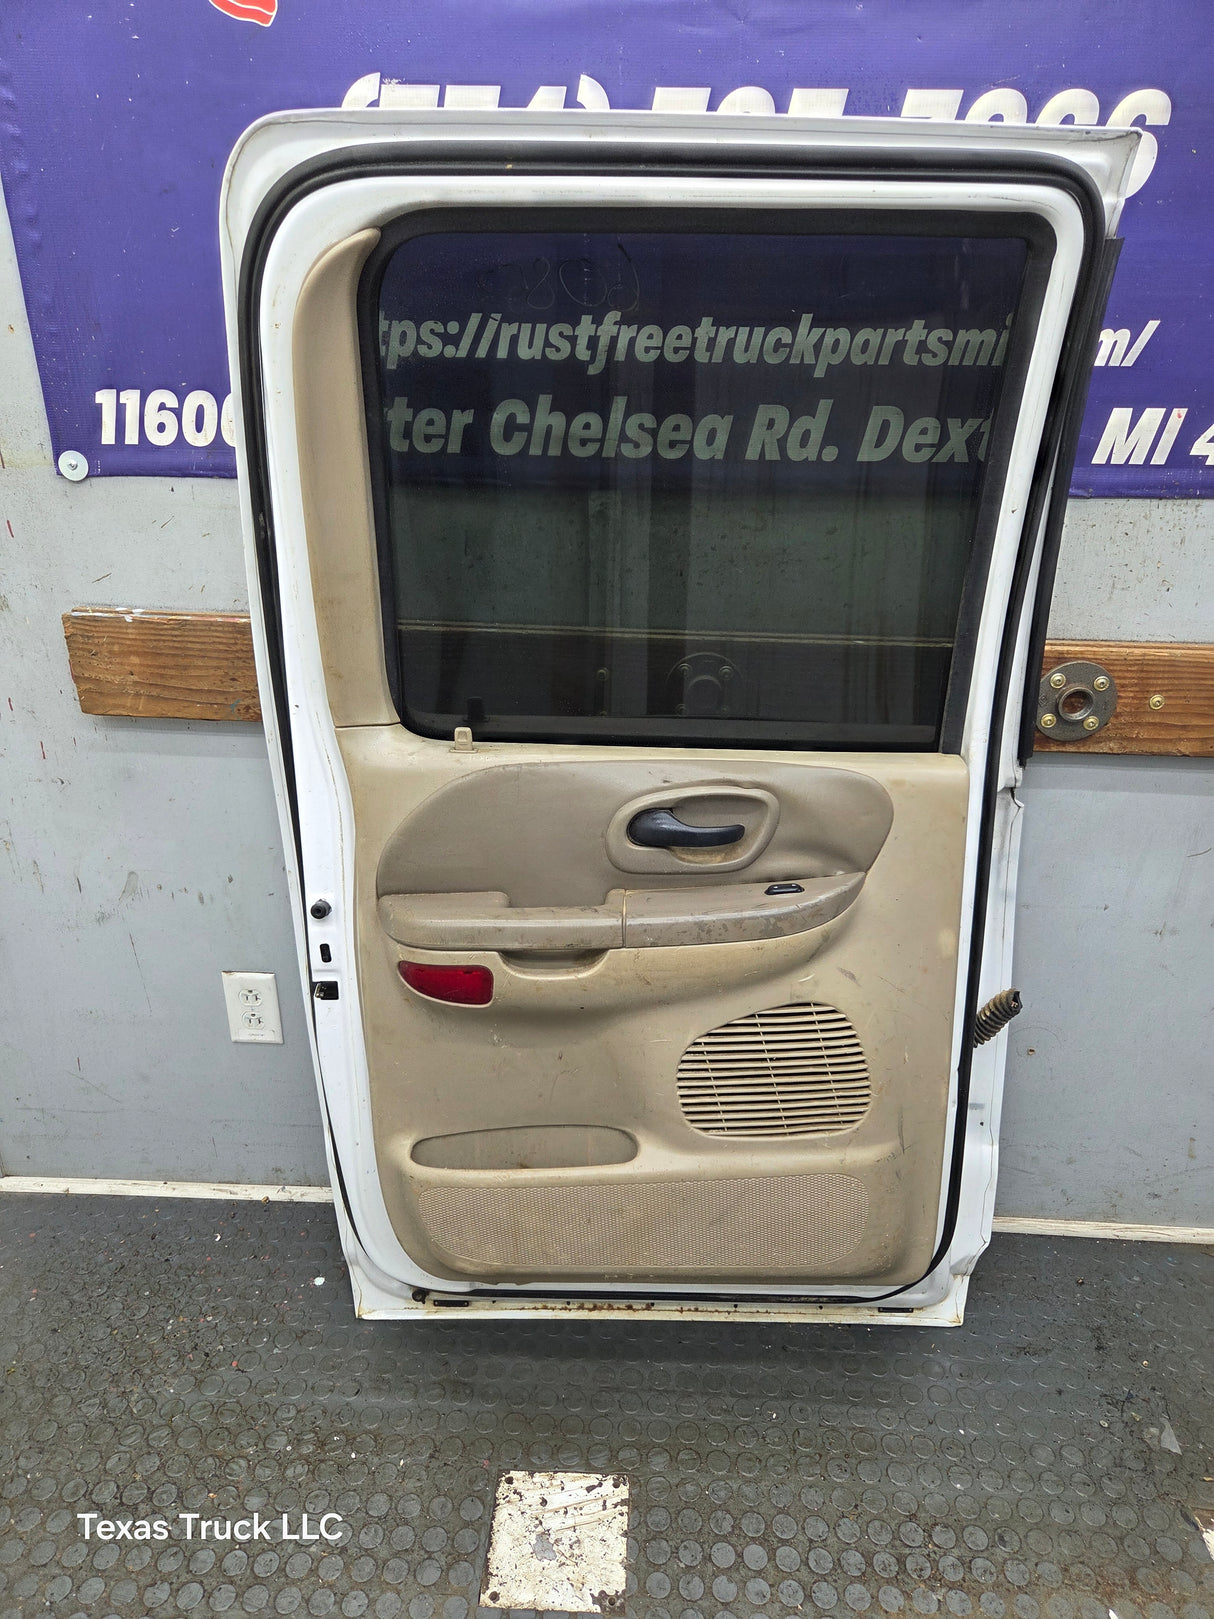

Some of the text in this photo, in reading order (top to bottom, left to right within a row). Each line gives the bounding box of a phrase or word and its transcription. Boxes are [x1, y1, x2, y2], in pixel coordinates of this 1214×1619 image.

[384, 397, 474, 454] ter
[490, 394, 734, 460] Chelsea
[745, 399, 839, 462] Rd.
[856, 405, 995, 463] Dex
[1091, 407, 1189, 465] MI
